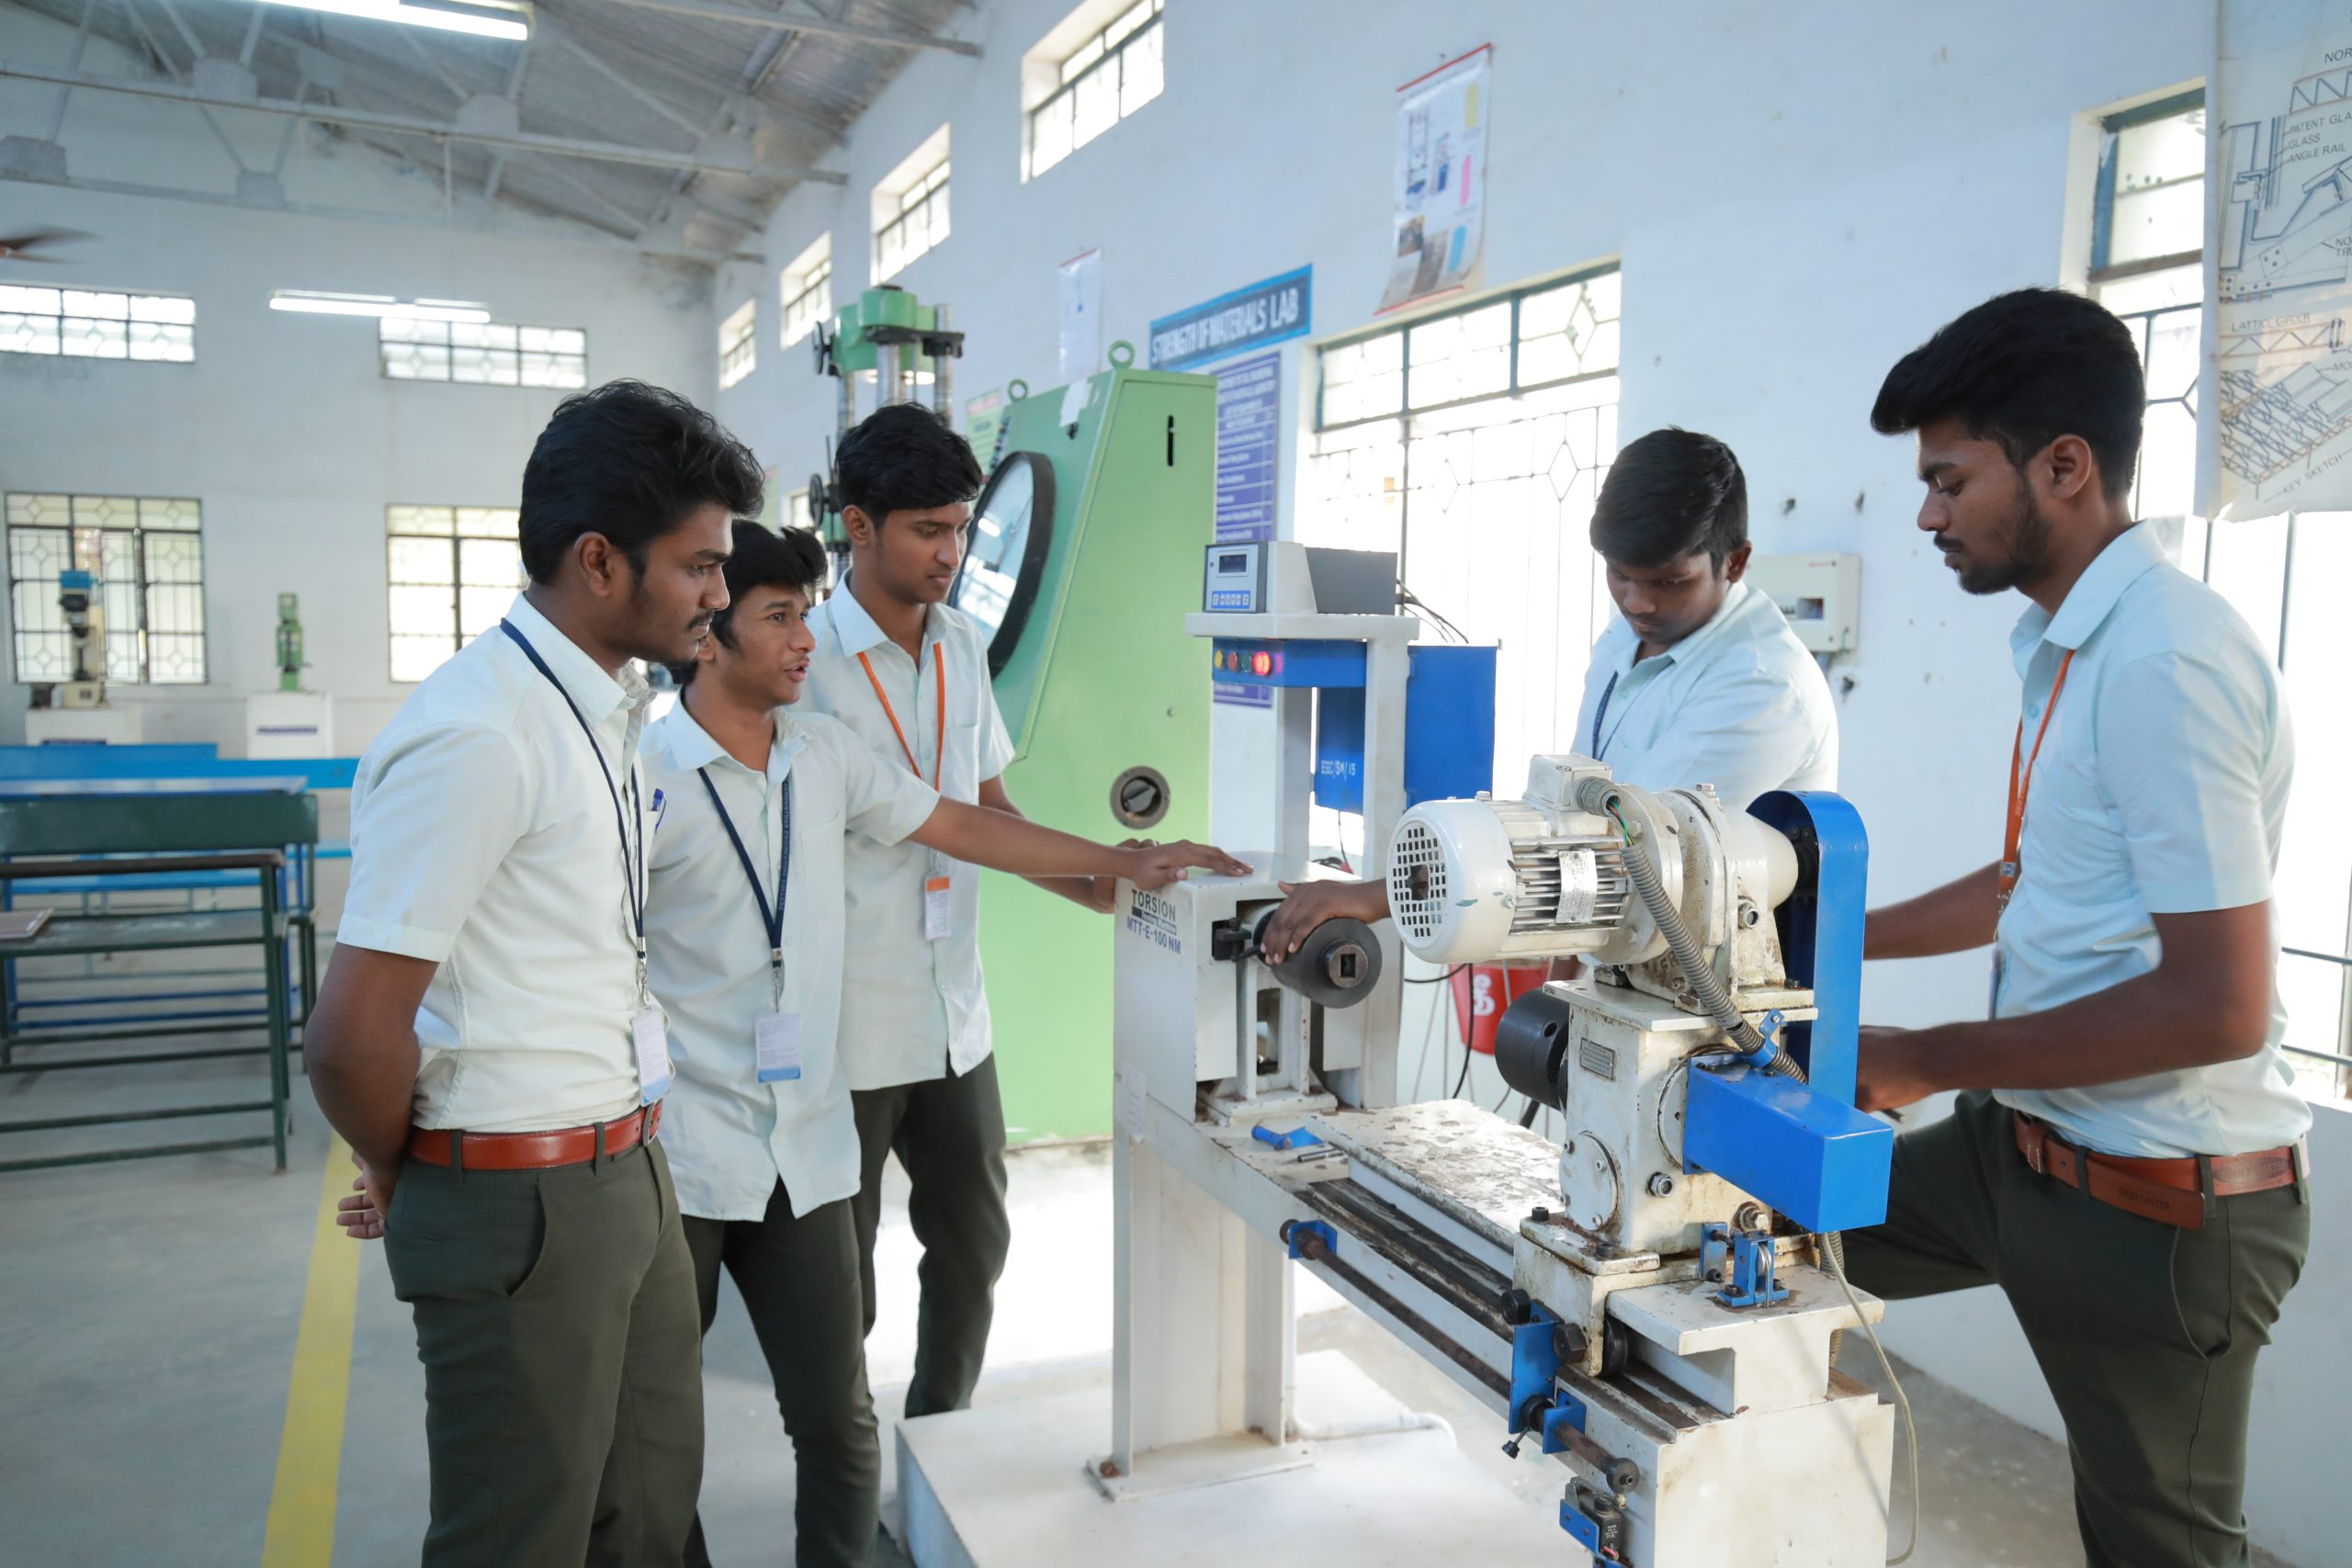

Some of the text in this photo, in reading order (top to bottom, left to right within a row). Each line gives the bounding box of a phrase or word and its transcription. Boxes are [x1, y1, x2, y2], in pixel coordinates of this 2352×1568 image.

[2290, 117, 2325, 134] PATENT
[2289, 132, 2321, 150] GLASS
[2288, 142, 2346, 163] ANGLE RAIL
[1270, 287, 1299, 329] LAB
[2282, 453, 2344, 494] KEY SKETCH
[1132, 888, 1176, 922] TORSION
[1168, 935, 1182, 955] NM
